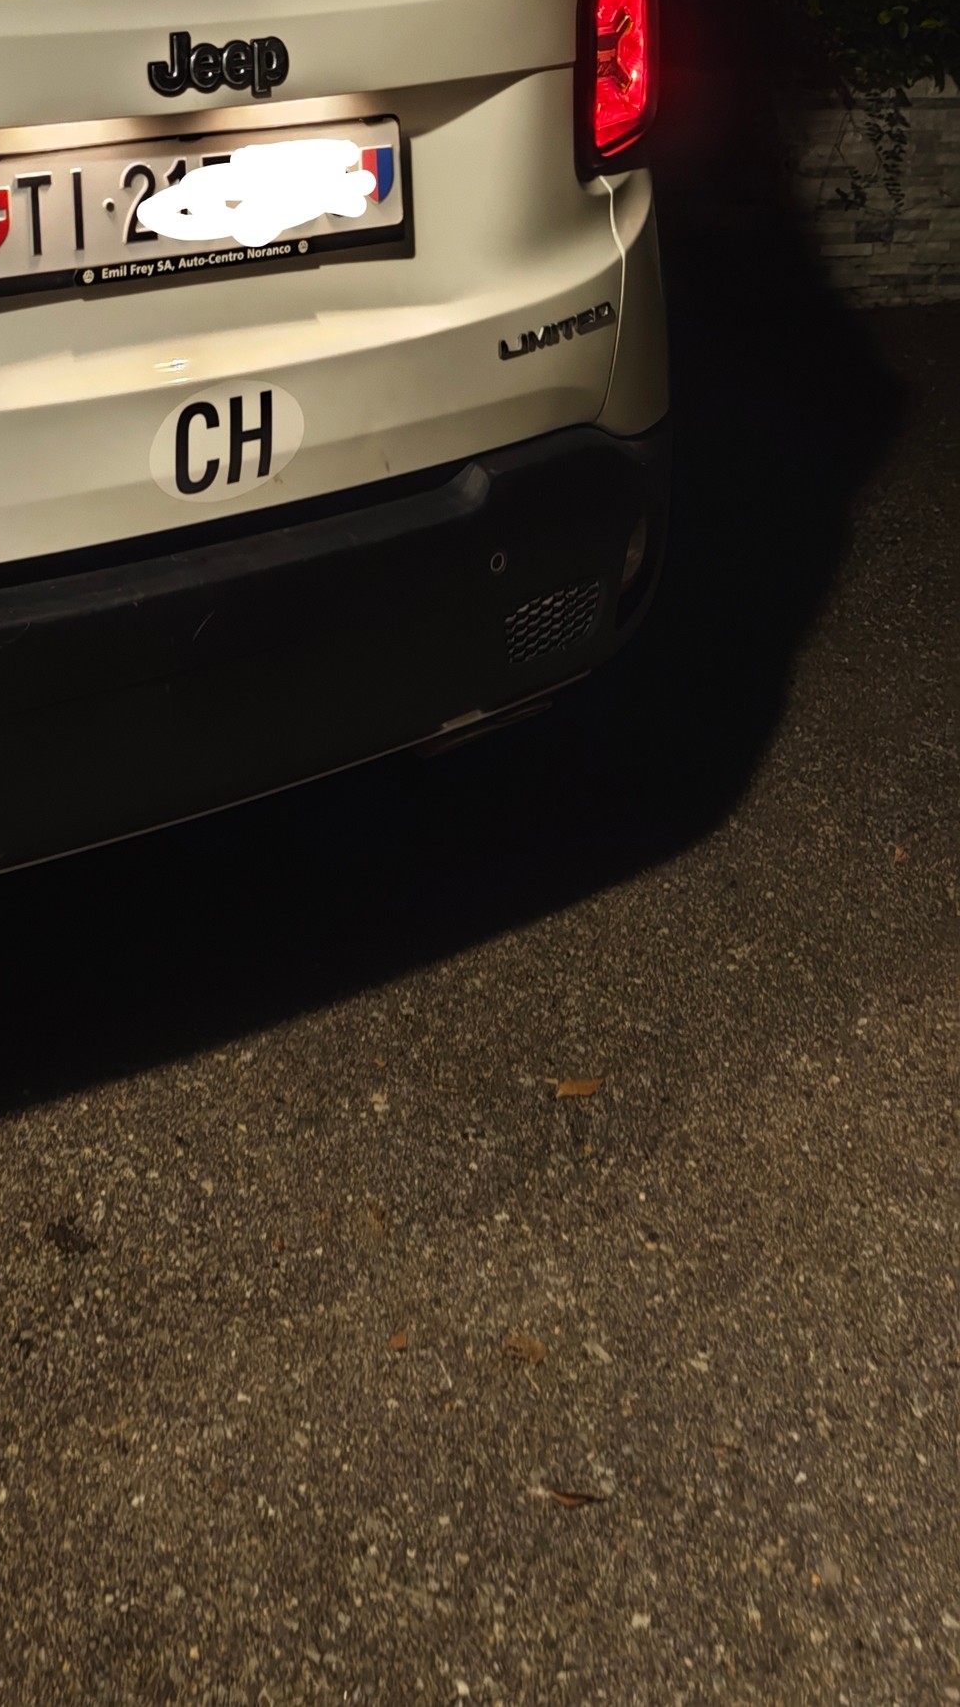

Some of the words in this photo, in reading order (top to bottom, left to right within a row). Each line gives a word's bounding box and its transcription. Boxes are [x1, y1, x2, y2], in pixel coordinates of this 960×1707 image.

[147, 31, 290, 99] Jeep
[101, 265, 128, 280] Emil
[130, 262, 155, 277] Frey
[157, 259, 175, 272] SA,
[178, 252, 244, 269] Auto-Centro
[247, 244, 291, 259] Noranco
[498, 301, 617, 361] LIMITED
[175, 389, 273, 495] CH
